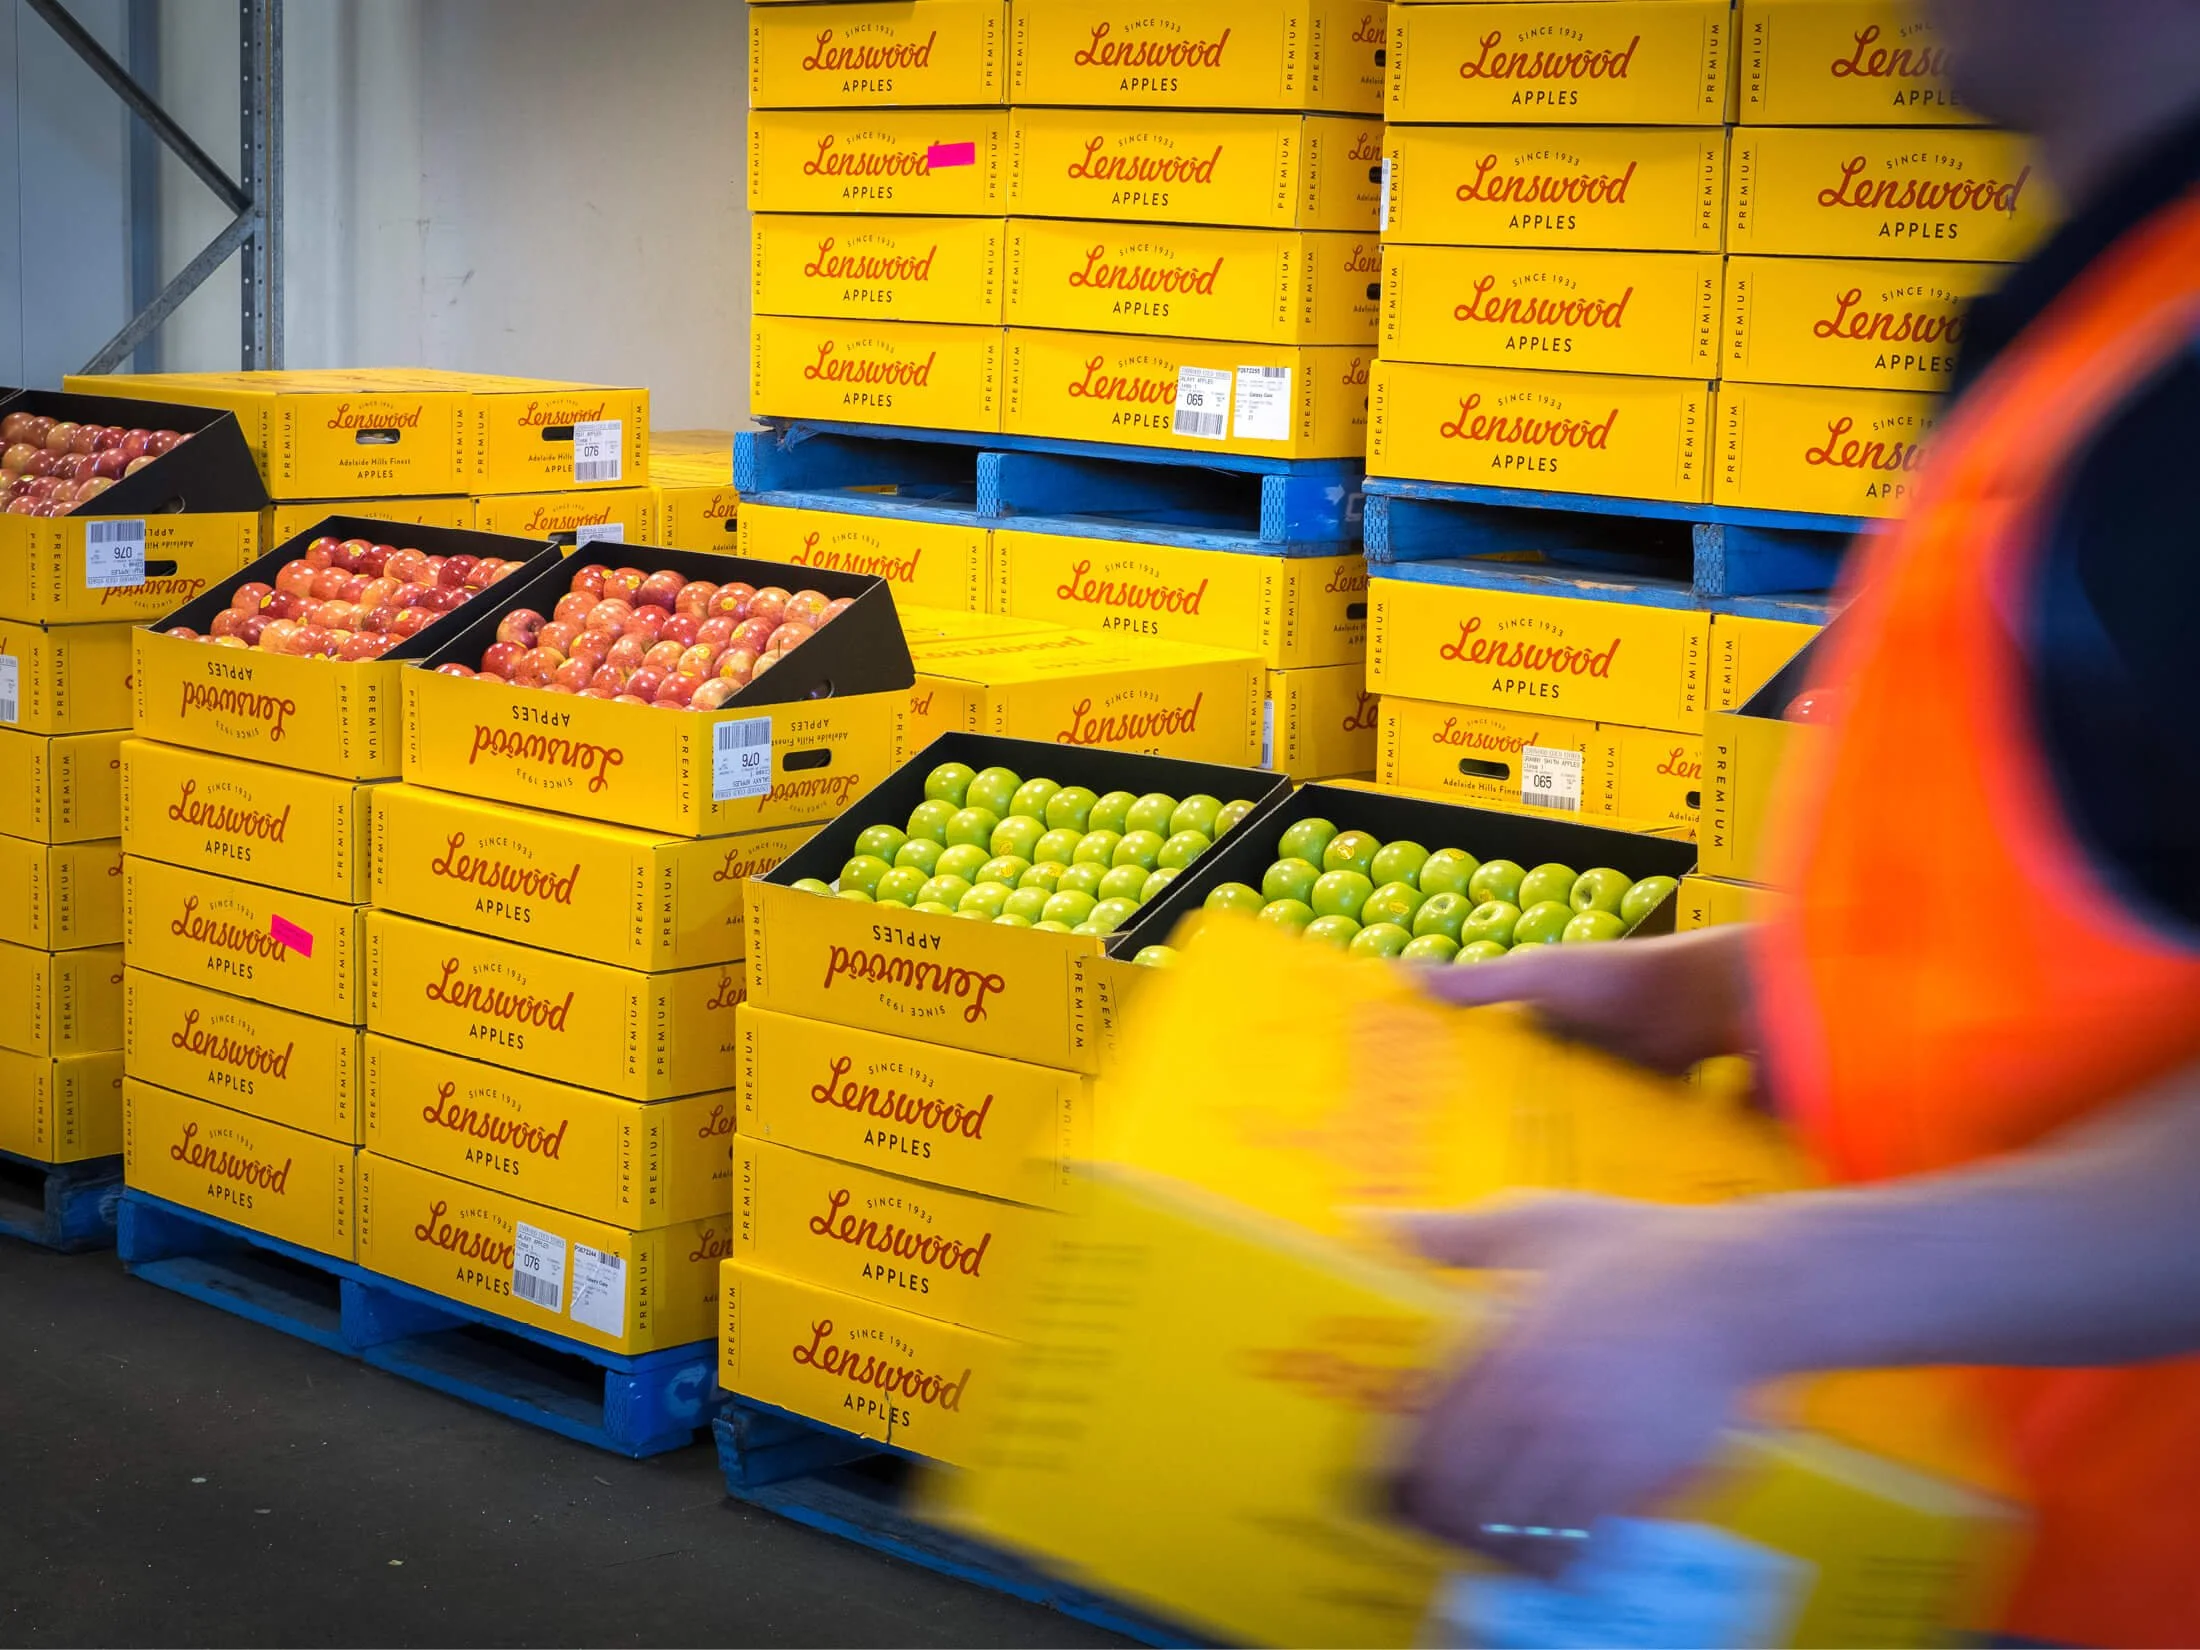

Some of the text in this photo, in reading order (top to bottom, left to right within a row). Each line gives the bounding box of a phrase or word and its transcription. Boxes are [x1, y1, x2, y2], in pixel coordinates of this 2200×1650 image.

[1125, 18, 1181, 32] SINCE 1933
[1519, 26, 1583, 42] SINCE 1933
[802, 29, 936, 71] Lenswood
[986, 19, 994, 86] PREMIUM
[1016, 19, 1024, 86] PREMIUM
[1075, 22, 1231, 67] Lenswood
[1286, 19, 1296, 90] PREMIUM
[1313, 20, 1321, 91] PREMIUM
[1460, 31, 1640, 79] Lenswood
[1393, 28, 1403, 101] PREMIUM
[1706, 25, 1720, 102] PREMIUM
[1751, 23, 1762, 102] PREMIUM
[843, 79, 892, 92] APPLES
[1120, 78, 1177, 91] APPLES
[1512, 91, 1577, 105] APPLES
[1118, 133, 1174, 148] SINCE 1933
[1068, 134, 1223, 183] Lenswood
[1278, 138, 1289, 208] PREMIUM
[1515, 151, 1579, 166] SINCE 1933
[1887, 153, 1963, 170] SINCE 1933
[843, 186, 892, 199] APPLES
[1456, 154, 1637, 204] Lenswood
[1702, 150, 1715, 228] PREMIUM
[1738, 151, 1750, 229] PREMIUM
[1818, 156, 2030, 212] Lenswood
[1112, 192, 1168, 206] APPLES
[1509, 215, 1575, 229] APPLES
[1879, 222, 1957, 239] APPLES
[804, 238, 937, 281] Lenswood
[1069, 244, 1224, 295] Lenswood
[843, 289, 892, 303] APPLES
[1512, 273, 1576, 289] SINCE 1933
[1882, 287, 1923, 302] SINCE
[1113, 301, 1168, 317] APPLES
[1387, 268, 1397, 339] PREMIUM
[1454, 273, 1633, 328] Lenswood
[1814, 288, 1967, 343] Lenswo
[1700, 280, 1712, 356] PREMIUM
[1734, 281, 1745, 358] PREMIUM
[1506, 336, 1572, 352] APPLES
[804, 339, 936, 387] Lenswood
[1875, 354, 1953, 372] APPLES
[1068, 355, 1178, 405] Lenswo
[843, 393, 892, 407] APPLES
[1185, 393, 1204, 408] 065
[1498, 393, 1562, 410] SINCE 1933
[328, 403, 422, 429] Lenswood
[1112, 412, 1169, 429] APPLES
[1374, 384, 1383, 455] PREMIUM
[1440, 393, 1618, 449] Lenswood
[584, 447, 598, 457] 076
[1683, 404, 1695, 480] PREMIUM
[1726, 406, 1737, 483] PREMIUM
[357, 470, 393, 478] APPLES
[1492, 454, 1557, 472] APPLES
[114, 546, 132, 559] 076
[1057, 560, 1208, 615] Lenswood
[1103, 617, 1158, 635] APPLES
[1263, 577, 1271, 645] PREMIUM
[1374, 603, 1383, 674] PREMIUM
[1499, 618, 1564, 637] SINCE 1933
[1440, 617, 1621, 678] Lenswood
[56, 648, 64, 716] PREMIUM
[208, 661, 252, 680] APPLES
[1686, 637, 1697, 711] PREMIUM
[1492, 678, 1559, 698] APPLES
[181, 680, 296, 741] Lenswood
[368, 685, 376, 759] PREMIUM
[512, 705, 570, 727] APPLES
[791, 719, 829, 731] APPLES
[1057, 691, 1203, 745] Lenswood
[1249, 677, 1260, 746] PREMIUM
[797, 736, 814, 744] Hills
[817, 733, 848, 743] Adelaide
[469, 725, 624, 793] Lenswood
[742, 752, 759, 767] 076
[541, 778, 573, 788] SINCE
[1443, 778, 1475, 789] Adelaide
[1479, 783, 1496, 792] Hills
[1534, 775, 1552, 788] 065
[1714, 746, 1726, 847] PREMIUM
[169, 779, 290, 843] Lenswood
[205, 840, 250, 861] APPLES
[479, 837, 532, 859] SINCE 1933
[432, 832, 580, 905] Lenswood
[475, 898, 530, 923] APPLES
[635, 867, 644, 945] PREMIUM
[663, 865, 671, 946] PREMIUM
[873, 925, 940, 950] APPLES
[208, 956, 252, 979] APPLES
[473, 963, 526, 986] SINCE 1933
[426, 958, 574, 1032] Lenswood
[824, 945, 1005, 1023] Lenswood
[880, 994, 945, 1017] SINCE 1933
[1074, 961, 1084, 1047] PREMIUM
[172, 1009, 294, 1079] Lenswood
[469, 1024, 523, 1049] APPLES
[629, 997, 637, 1074] PREMIUM
[208, 1070, 253, 1095] APPLES
[869, 1063, 934, 1088] SINCE 1933
[811, 1056, 993, 1140] Lenswood
[423, 1081, 568, 1160] Lenswood
[171, 1122, 292, 1195] Lenswood
[864, 1129, 930, 1158] APPLES
[466, 1148, 519, 1175] APPLES
[208, 1184, 252, 1208] APPLES
[867, 1198, 932, 1223] SINCE 1933
[810, 1190, 992, 1277] Lenswood
[524, 1254, 540, 1273] 076
[862, 1263, 928, 1293] APPLES
[456, 1267, 510, 1296] APPLES
[639, 1252, 647, 1329] PREMIUM
[850, 1329, 914, 1357] SINCE 1933
[793, 1319, 971, 1412] Lenswood
[844, 1394, 911, 1427] APPLES
